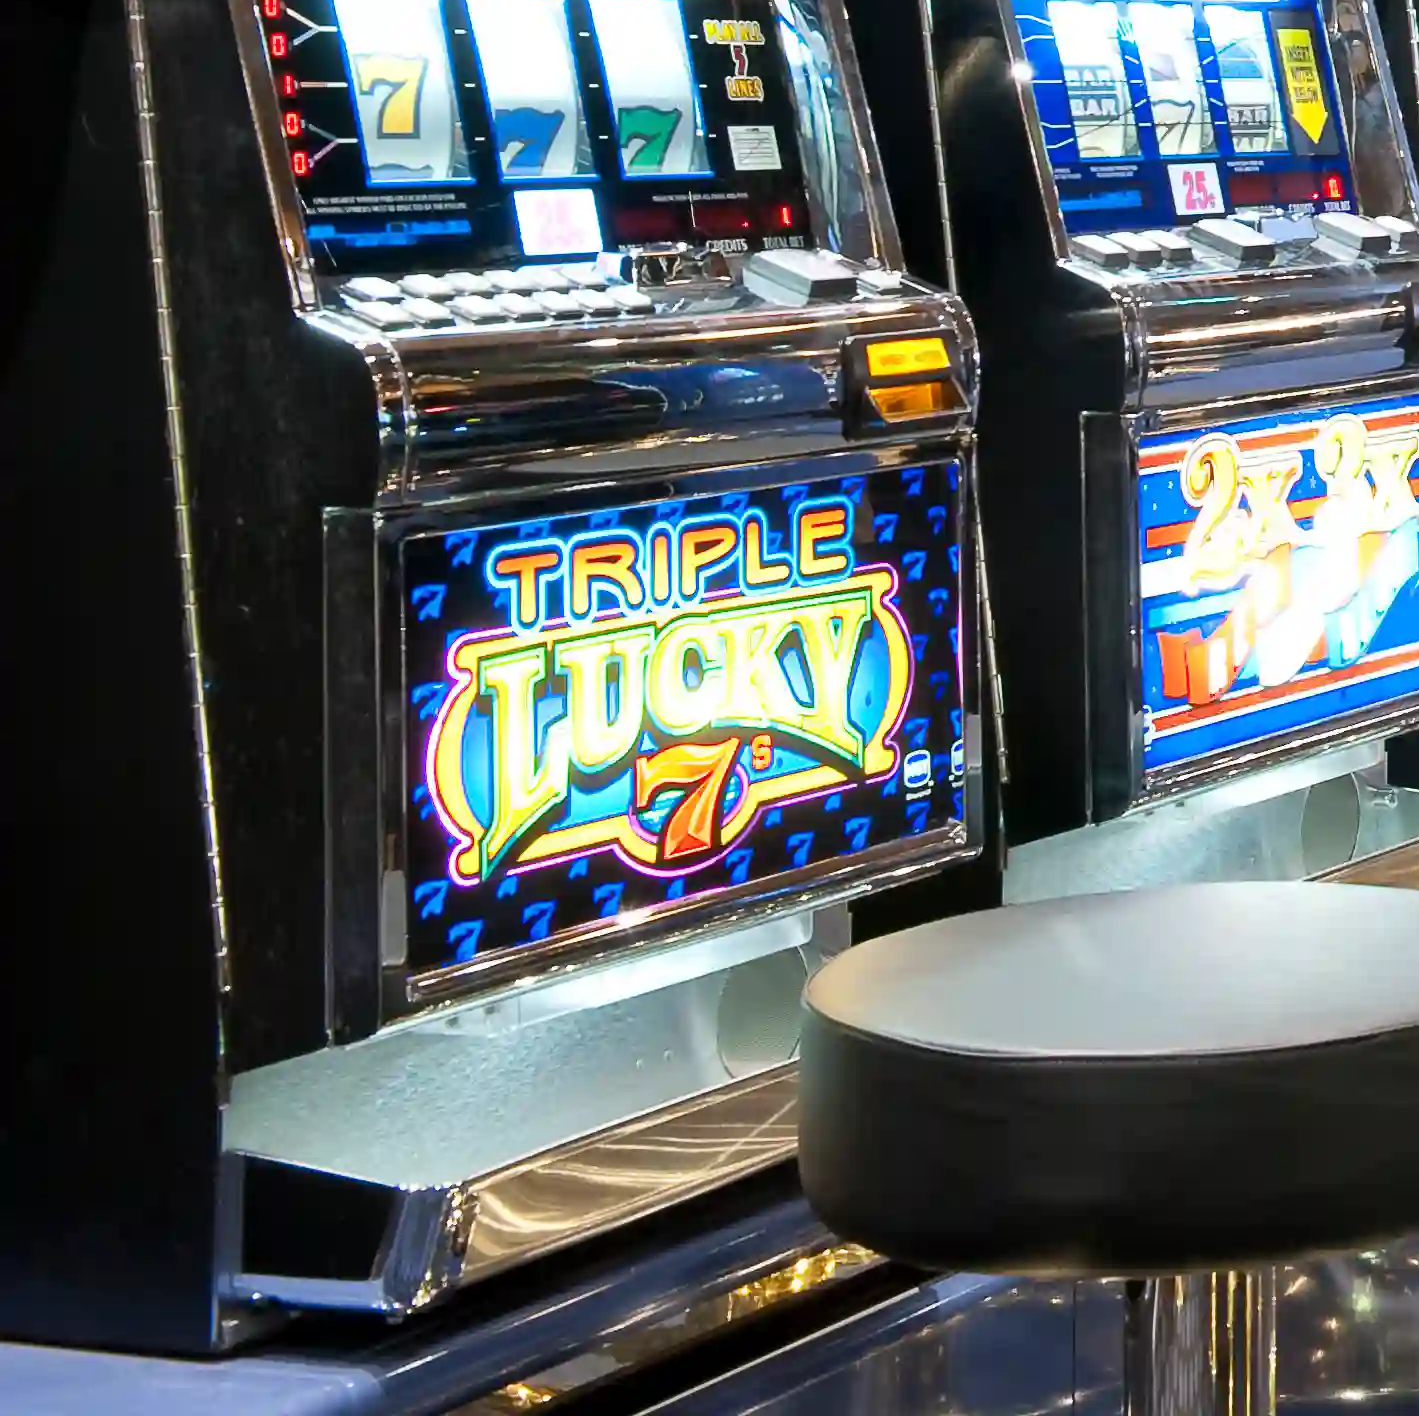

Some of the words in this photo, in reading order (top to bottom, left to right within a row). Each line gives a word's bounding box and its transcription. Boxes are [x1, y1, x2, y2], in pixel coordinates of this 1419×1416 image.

[270, 32, 288, 58] 0
[285, 110, 301, 136] 0
[358, 53, 428, 139] 7
[292, 150, 309, 175] 0
[493, 504, 851, 629] TRIPLE
[480, 589, 872, 881] LUCKY
